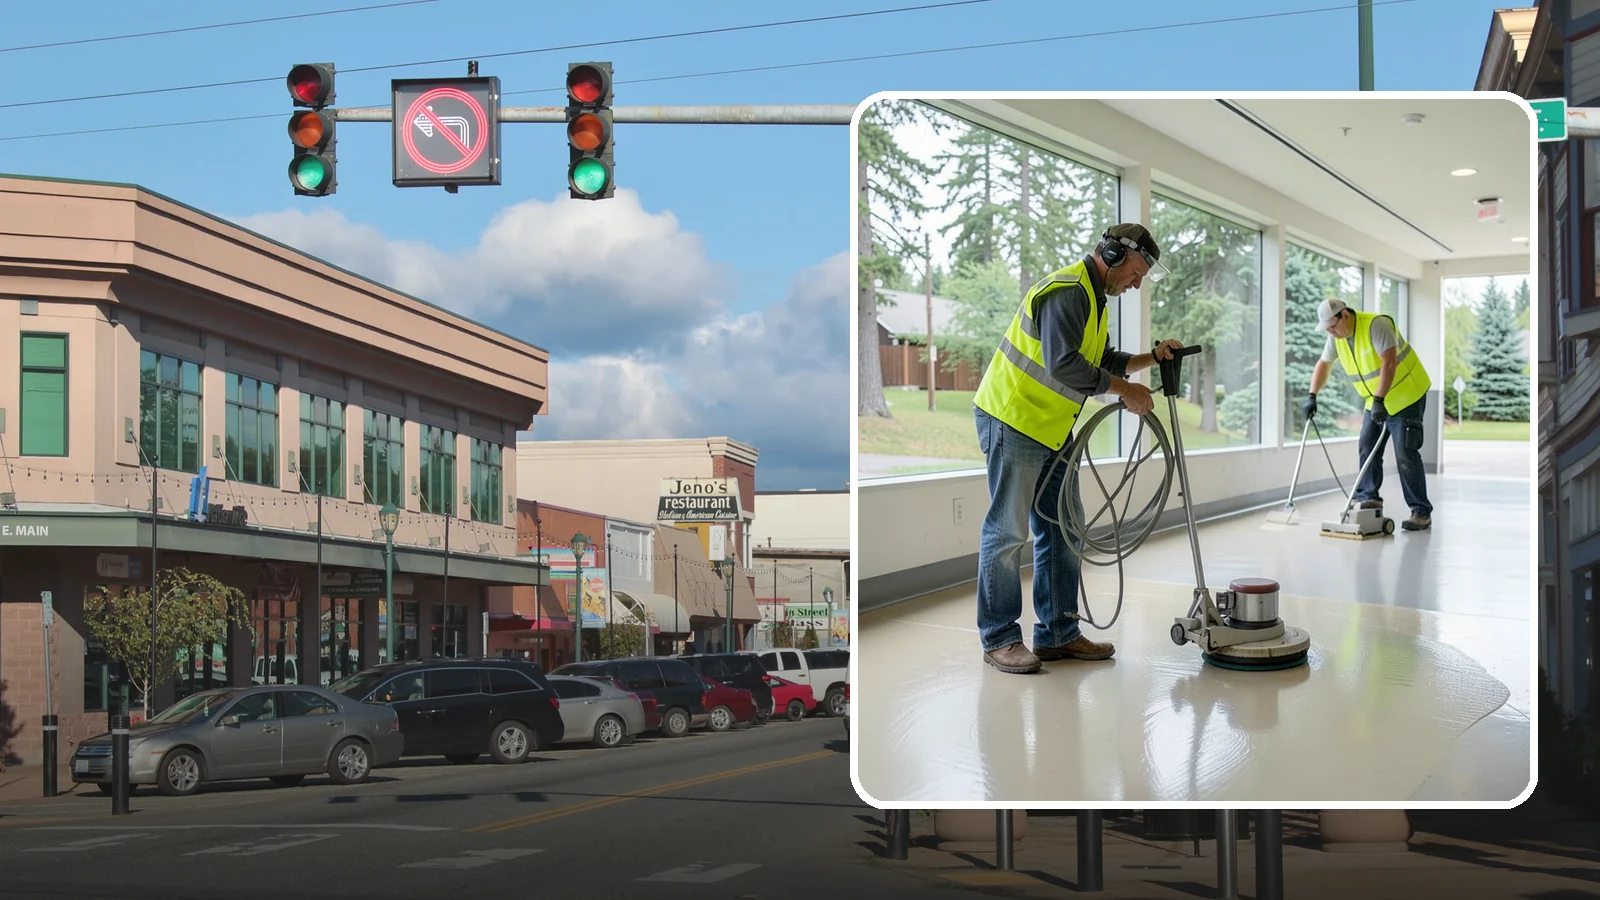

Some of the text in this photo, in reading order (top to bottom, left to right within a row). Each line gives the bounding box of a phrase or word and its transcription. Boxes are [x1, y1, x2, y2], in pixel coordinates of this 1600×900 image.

[669, 480, 727, 495] Jeno's
[665, 496, 731, 509] restaurant
[686, 510, 714, 519] American
[714, 510, 737, 519] Cuisine
[2, 525, 49, 536] E. MAIN
[797, 607, 829, 617] Street
